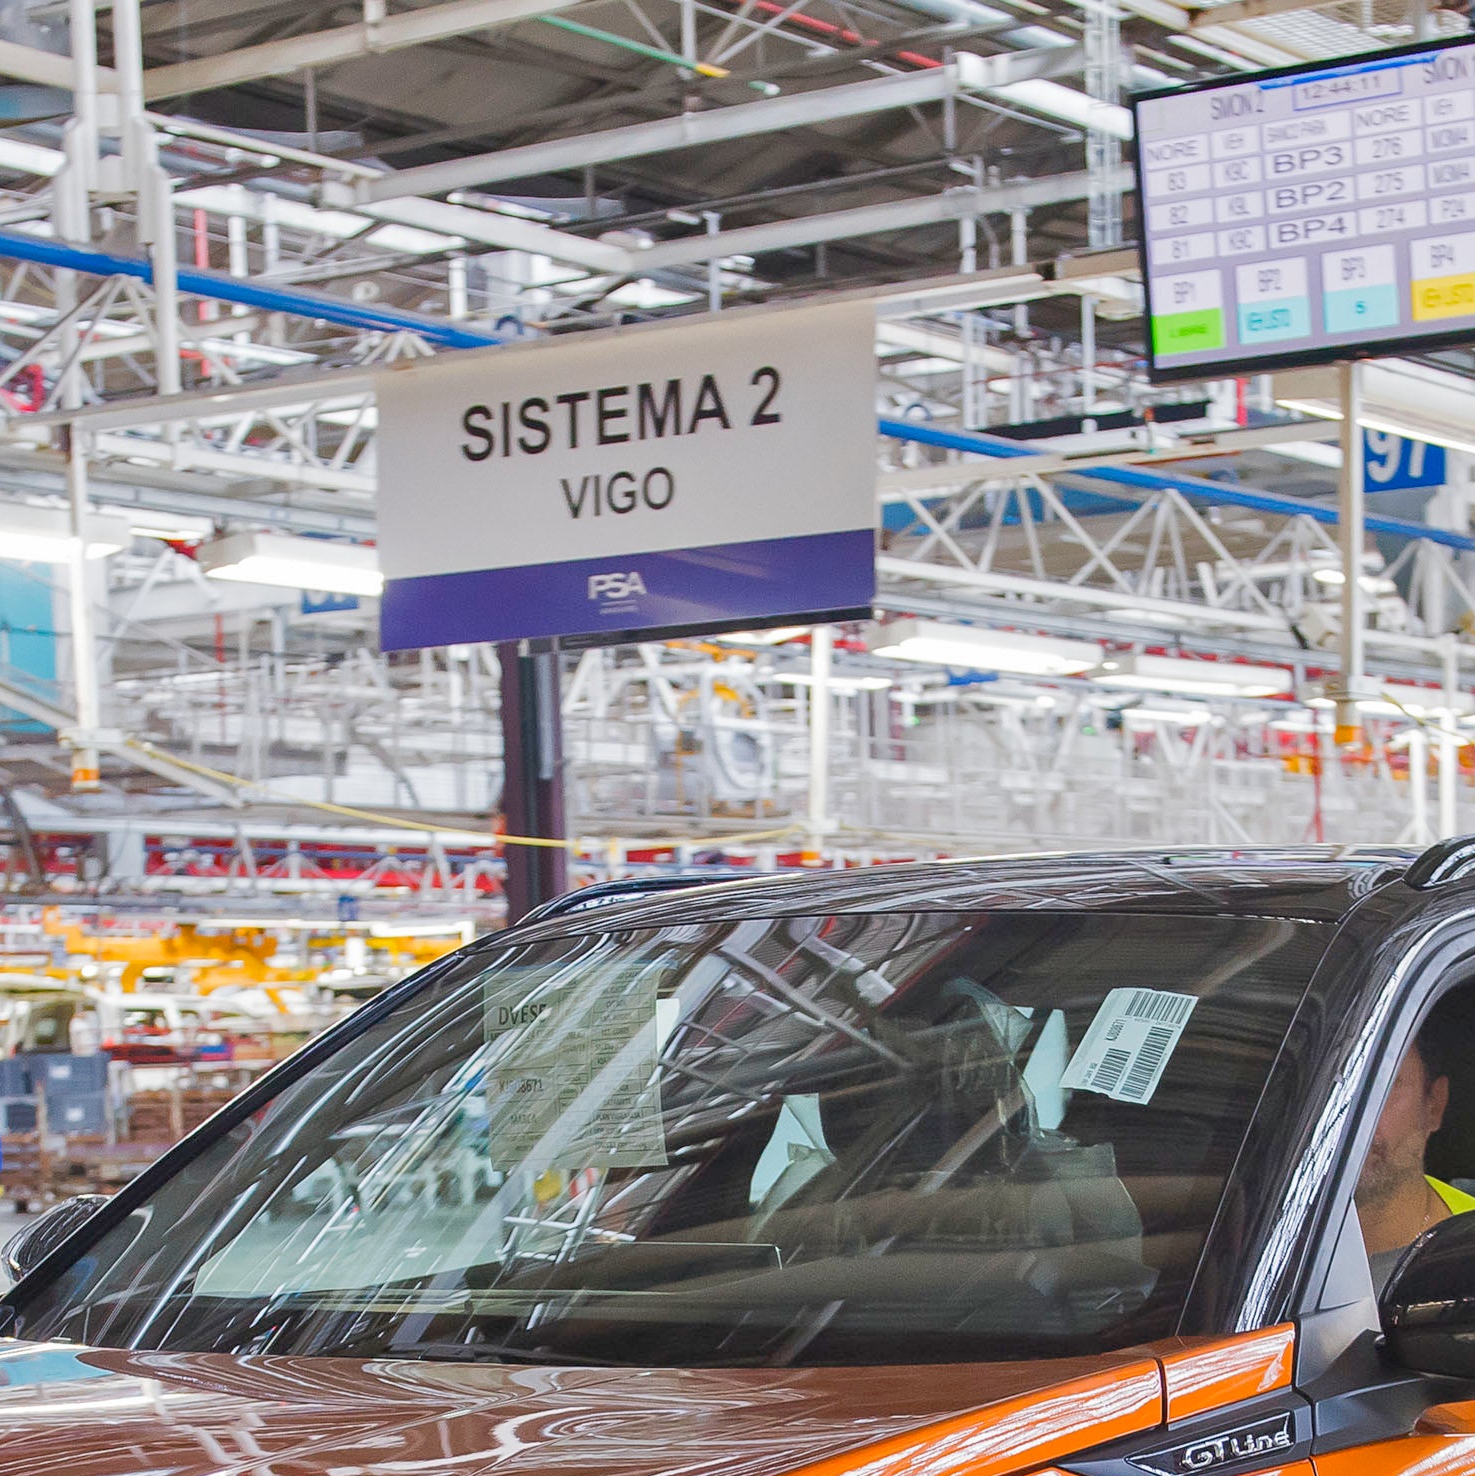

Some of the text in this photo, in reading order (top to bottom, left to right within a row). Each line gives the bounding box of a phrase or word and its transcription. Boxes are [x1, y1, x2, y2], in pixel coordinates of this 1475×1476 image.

[1356, 105, 1410, 127] NORE
[1146, 140, 1199, 161] NORE
[1274, 146, 1344, 174] BP3
[1276, 181, 1346, 209] BP2
[1277, 215, 1348, 244] BP4
[461, 365, 783, 462] SISTEMA 2
[560, 466, 676, 519] VIGO
[587, 571, 648, 600] PSA
[1178, 1436, 1230, 1470] GT
